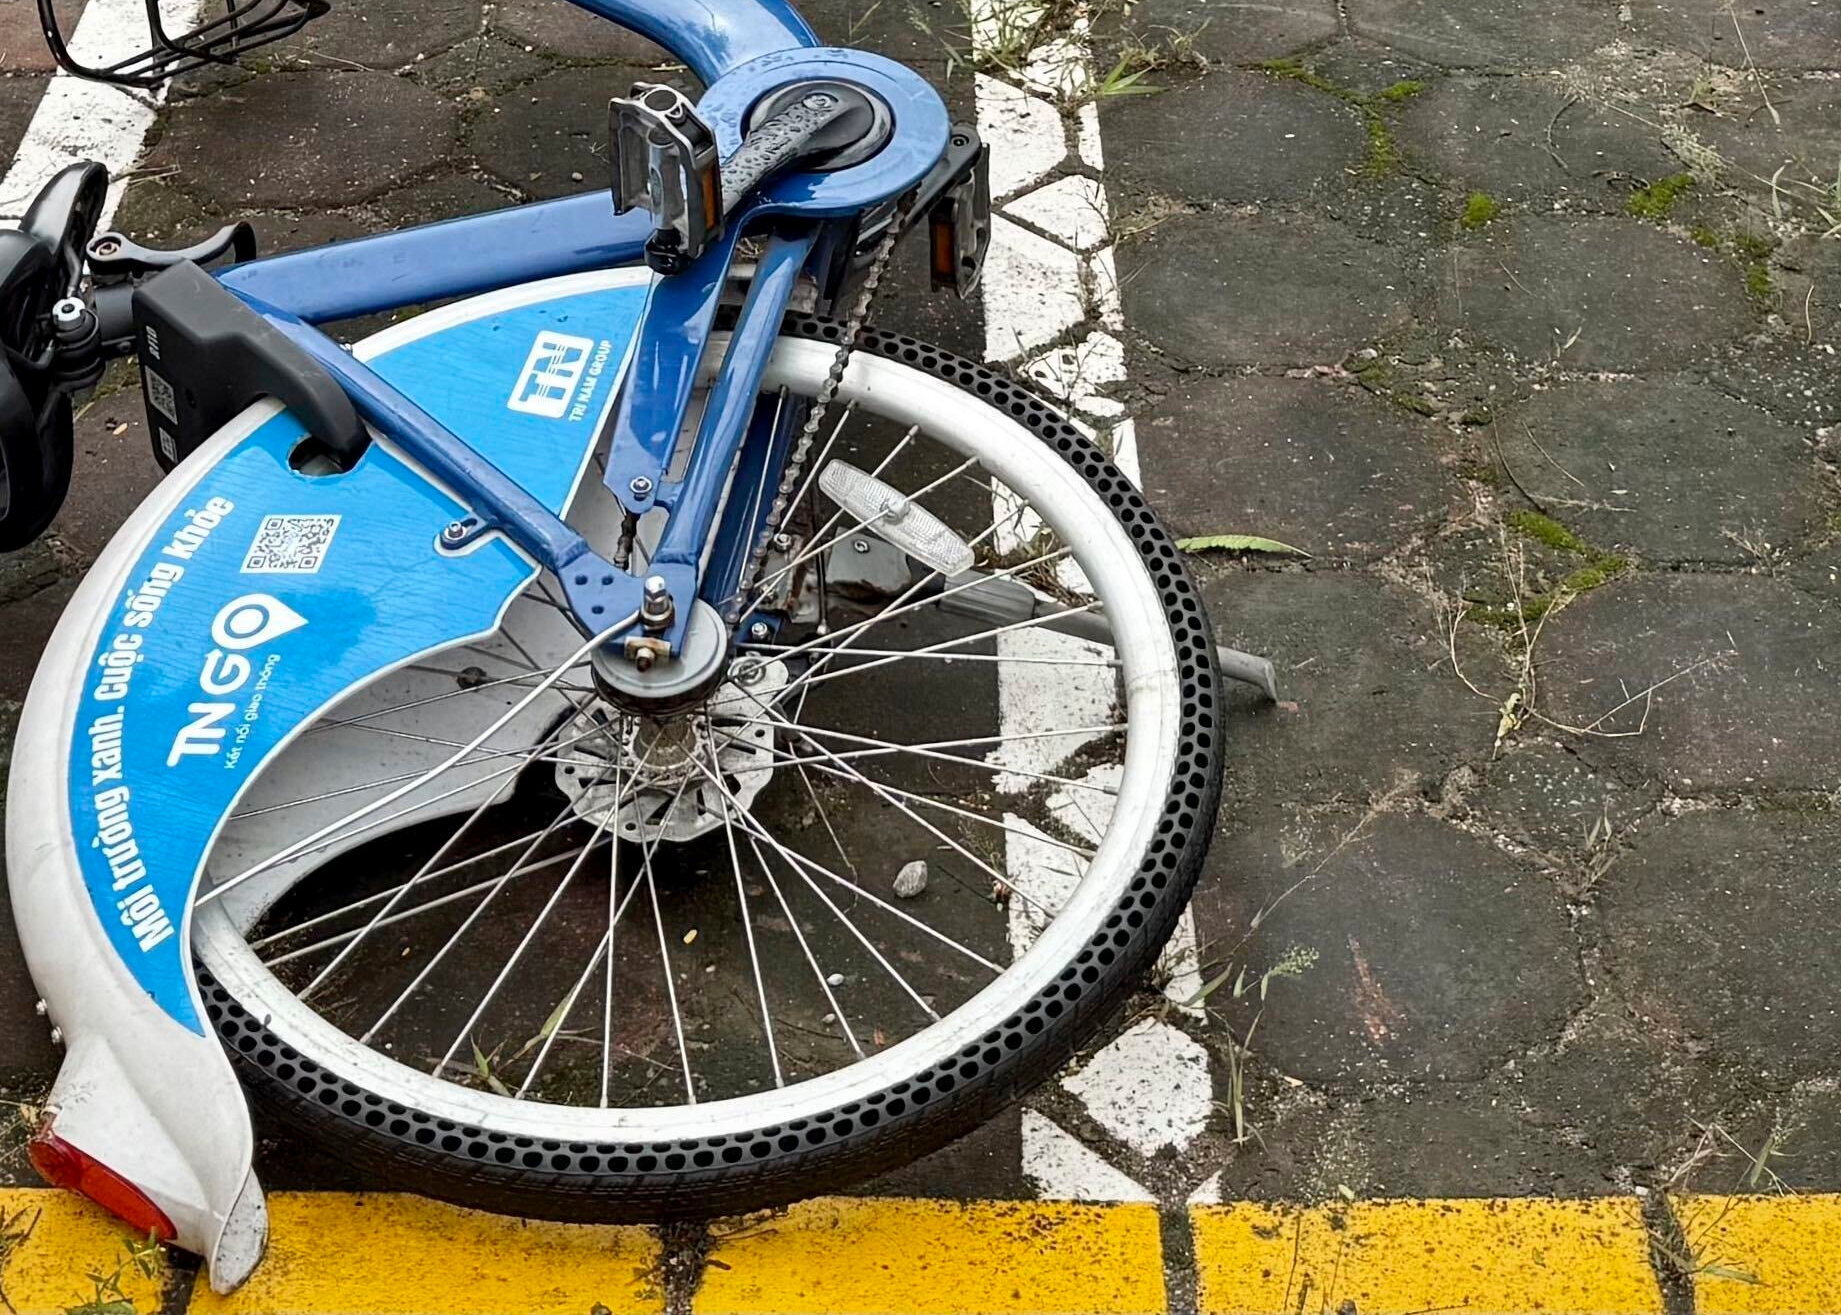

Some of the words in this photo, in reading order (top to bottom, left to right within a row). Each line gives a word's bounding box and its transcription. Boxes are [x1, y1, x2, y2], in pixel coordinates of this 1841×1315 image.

[577, 376, 598, 404] NAM
[588, 339, 612, 377] GROUP
[162, 496, 236, 560] khỏe
[124, 562, 185, 629] sống
[166, 593, 309, 767] TNGO
[244, 693, 263, 721] giao
[254, 653, 282, 692] thông
[88, 705, 126, 787] xanh.
[91, 786, 147, 892] trường
[117, 884, 176, 953] Môi
